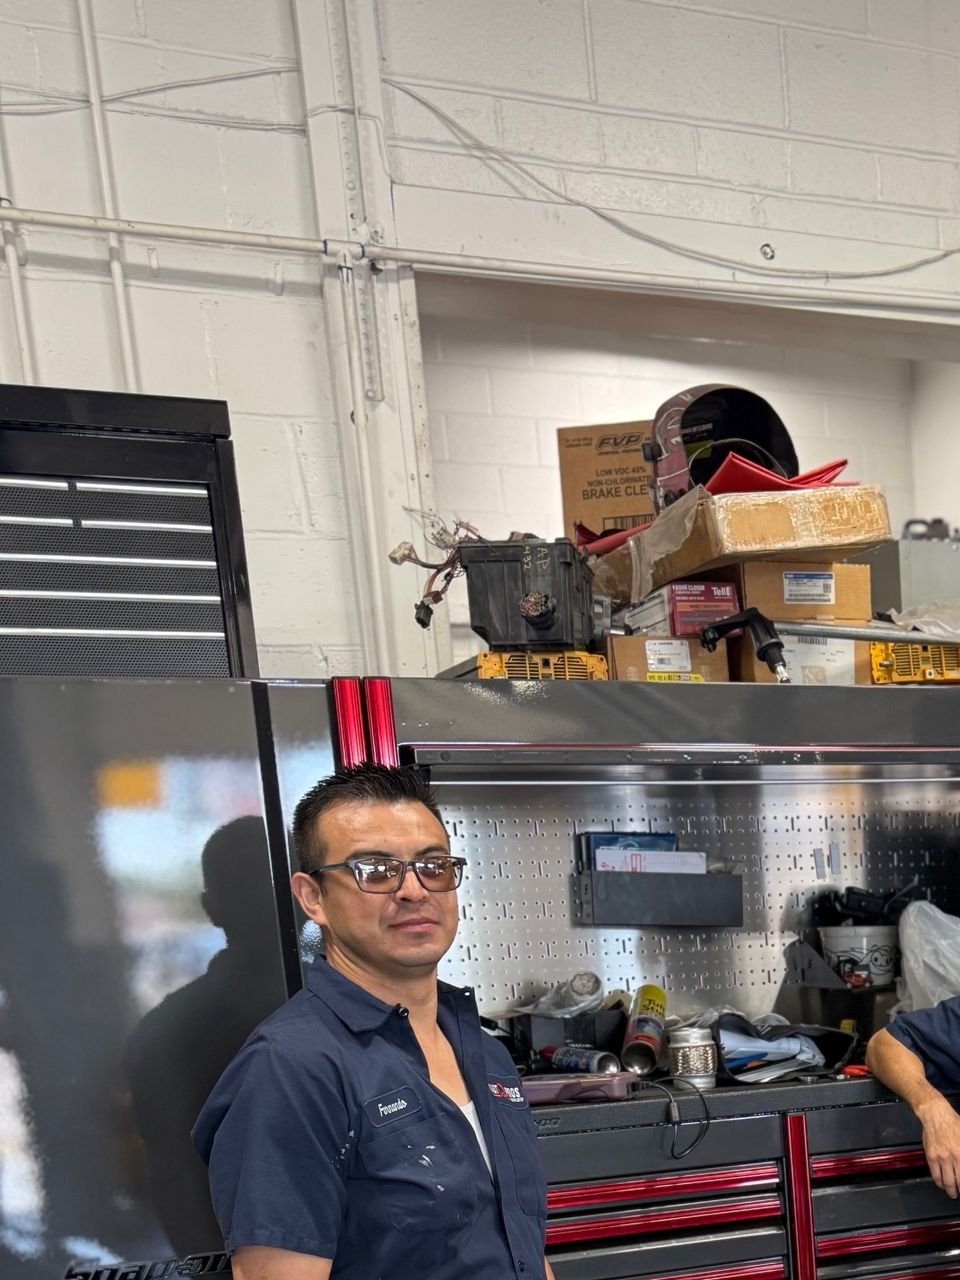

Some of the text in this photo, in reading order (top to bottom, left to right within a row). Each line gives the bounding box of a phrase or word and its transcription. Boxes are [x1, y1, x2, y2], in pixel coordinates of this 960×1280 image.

[596, 433, 643, 450] FVP
[595, 469, 612, 477] LOW
[614, 467, 630, 475] VOC
[582, 485, 649, 500] BRAKE CLE
